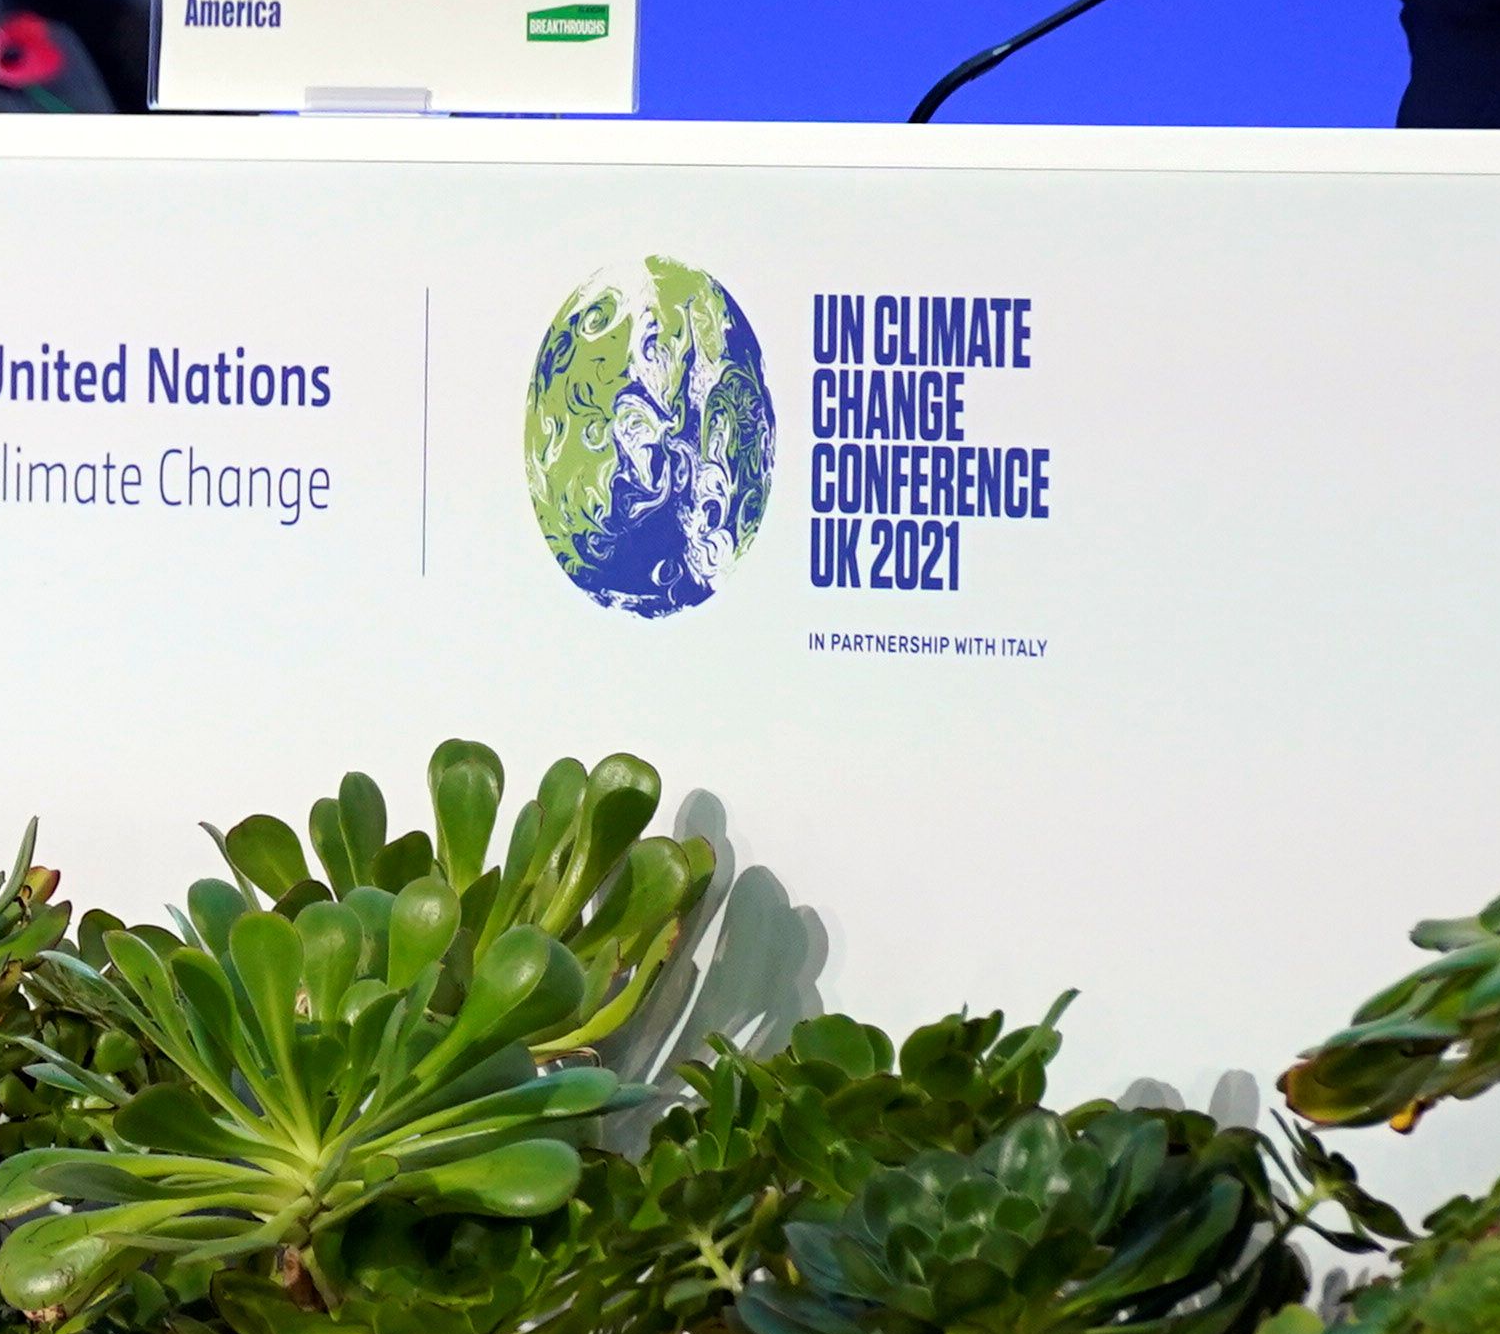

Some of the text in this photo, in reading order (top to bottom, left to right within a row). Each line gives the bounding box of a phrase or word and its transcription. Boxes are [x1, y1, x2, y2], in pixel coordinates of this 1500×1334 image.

[530, 18, 606, 35] BREAKTHROUGHS
[813, 294, 1031, 368] UN CLIMATE
[149, 347, 330, 407] Nations
[813, 366, 964, 441] CHANGE
[159, 446, 330, 526] Change
[811, 443, 1049, 518] CONFERENCE
[811, 518, 959, 591] UK 2021
[809, 633, 1047, 657] IN PARTNERSHIP WITH ITALY
